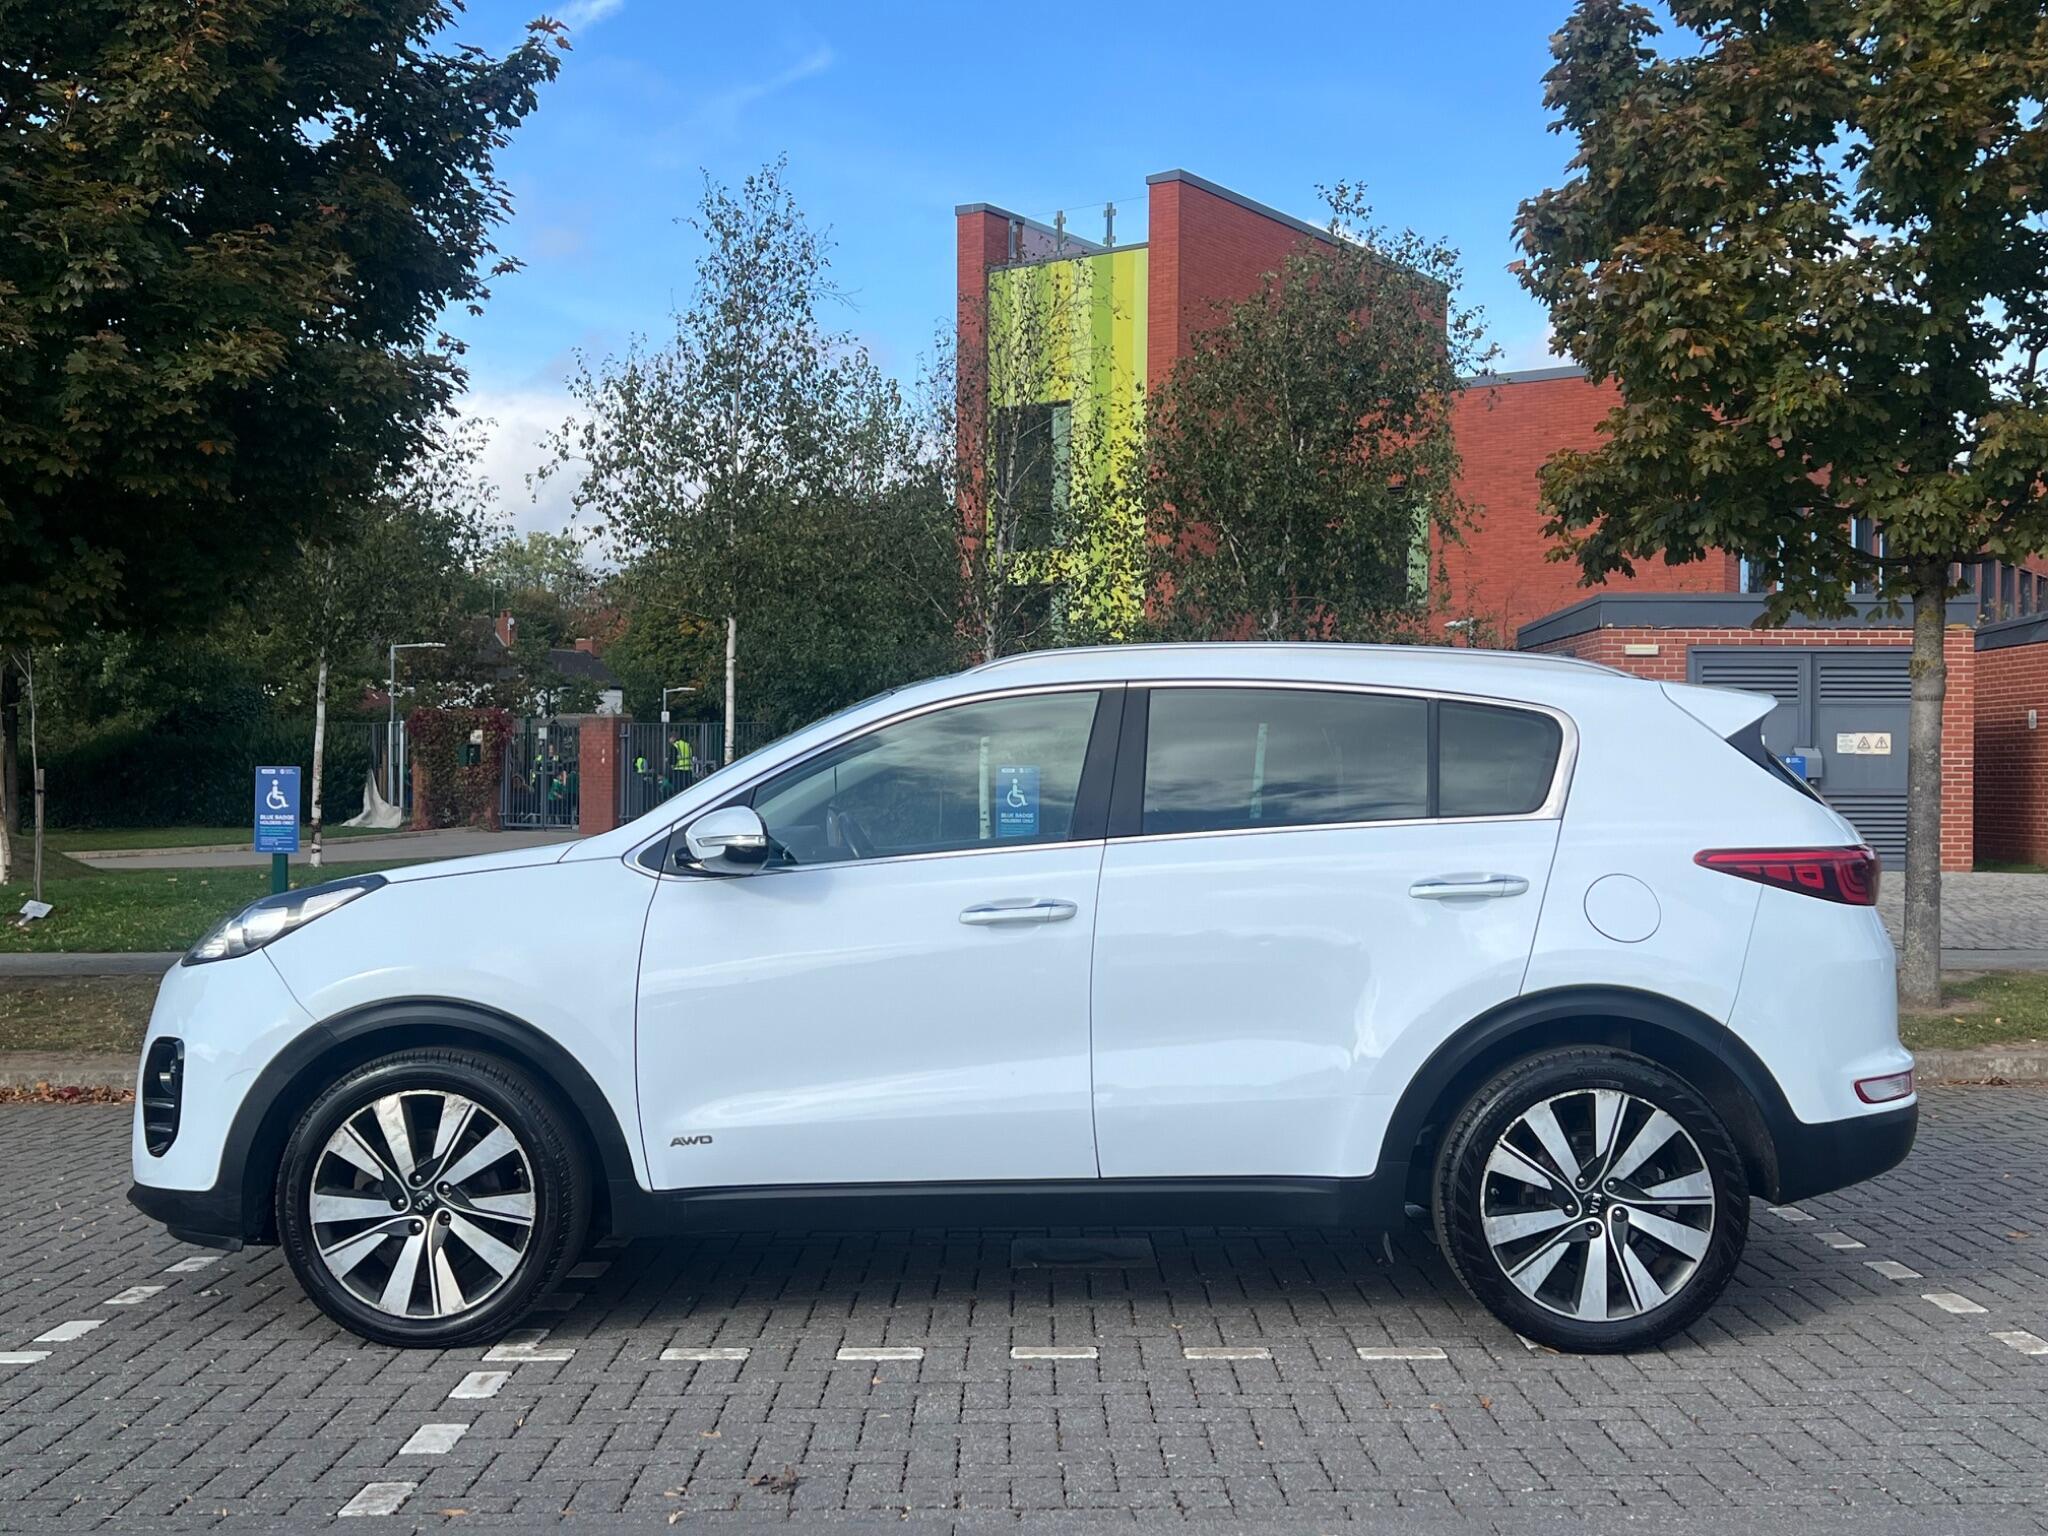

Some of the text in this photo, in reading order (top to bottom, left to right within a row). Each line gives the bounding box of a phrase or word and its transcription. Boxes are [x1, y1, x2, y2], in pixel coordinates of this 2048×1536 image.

[670, 1135, 713, 1147] AWD
[415, 1193, 435, 1211] KIA
[1589, 1192, 1602, 1214] KIA
